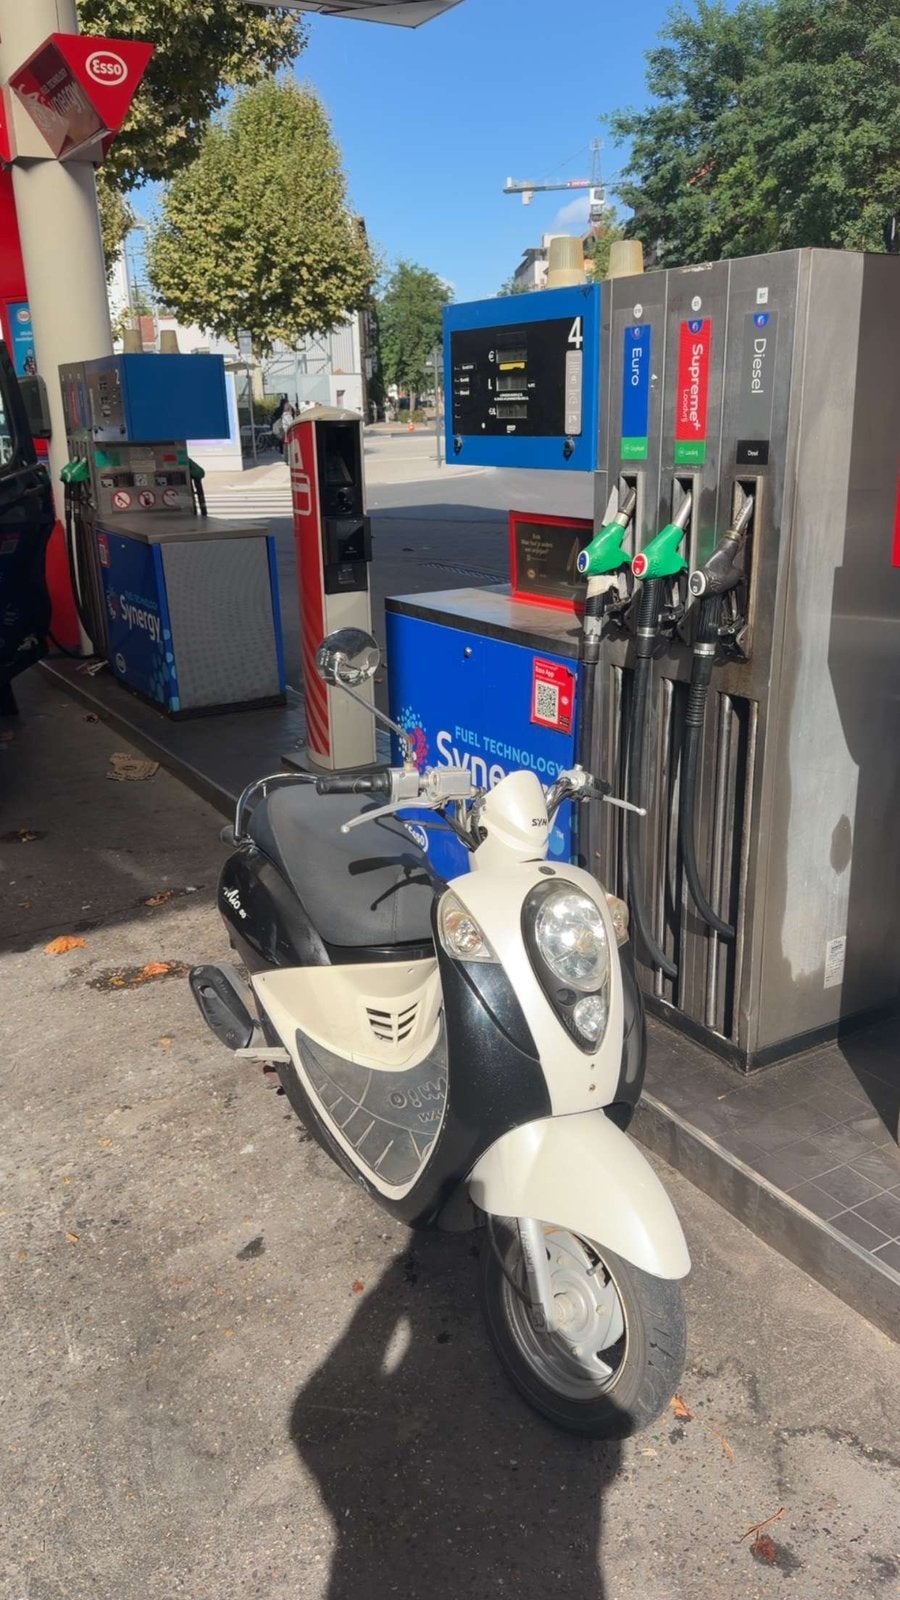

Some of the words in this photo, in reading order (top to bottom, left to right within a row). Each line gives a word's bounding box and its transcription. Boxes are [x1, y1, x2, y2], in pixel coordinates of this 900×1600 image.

[92, 58, 122, 76] Esso
[488, 350, 495, 362] €
[568, 316, 583, 349] 4
[631, 347, 642, 386] Euro
[687, 343, 704, 431] Supreme+
[751, 338, 767, 393] Diesel
[120, 594, 160, 643] Synergy
[436, 730, 513, 794] Syne
[455, 726, 480, 748] FUEL
[483, 736, 565, 777] TECHNOLOGY
